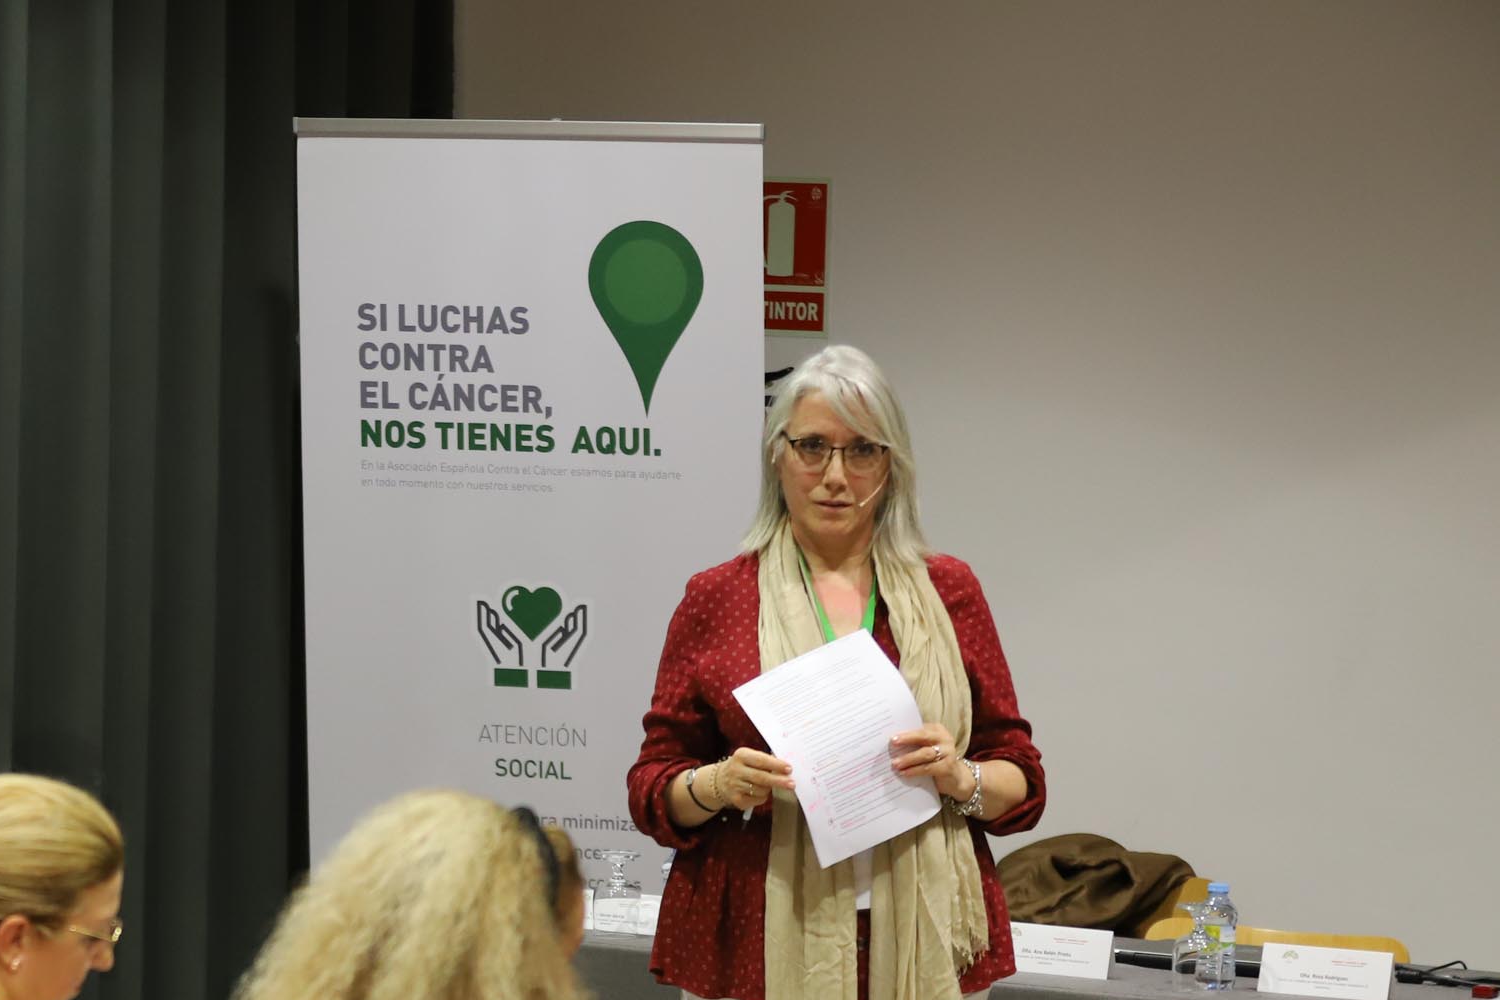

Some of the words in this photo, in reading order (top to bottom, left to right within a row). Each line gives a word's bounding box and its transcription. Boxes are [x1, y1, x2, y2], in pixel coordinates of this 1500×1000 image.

[357, 303, 388, 331] SI
[398, 304, 529, 335] LUCHAS
[358, 342, 495, 373] CONTRA
[360, 380, 400, 409] EL
[408, 374, 553, 419] CÁNCER,
[361, 420, 426, 449] NOS
[435, 422, 555, 453] TIENES
[571, 425, 662, 457] AQUI.
[361, 460, 373, 470] En
[376, 460, 385, 471] la
[387, 460, 438, 473] Asociación
[440, 462, 484, 475] Española
[487, 463, 519, 475] Contra
[522, 465, 531, 476] el
[570, 467, 612, 478] estamos
[614, 469, 636, 480] para
[639, 469, 682, 481] ayudarte
[361, 479, 373, 487] en
[375, 477, 397, 488] todo
[399, 478, 444, 489] momento
[446, 481, 464, 490] con
[466, 480, 509, 491] nuestros
[478, 723, 587, 748] ATENCIÓN
[494, 758, 573, 780] SOCIAL
[563, 814, 638, 832] minimiza
